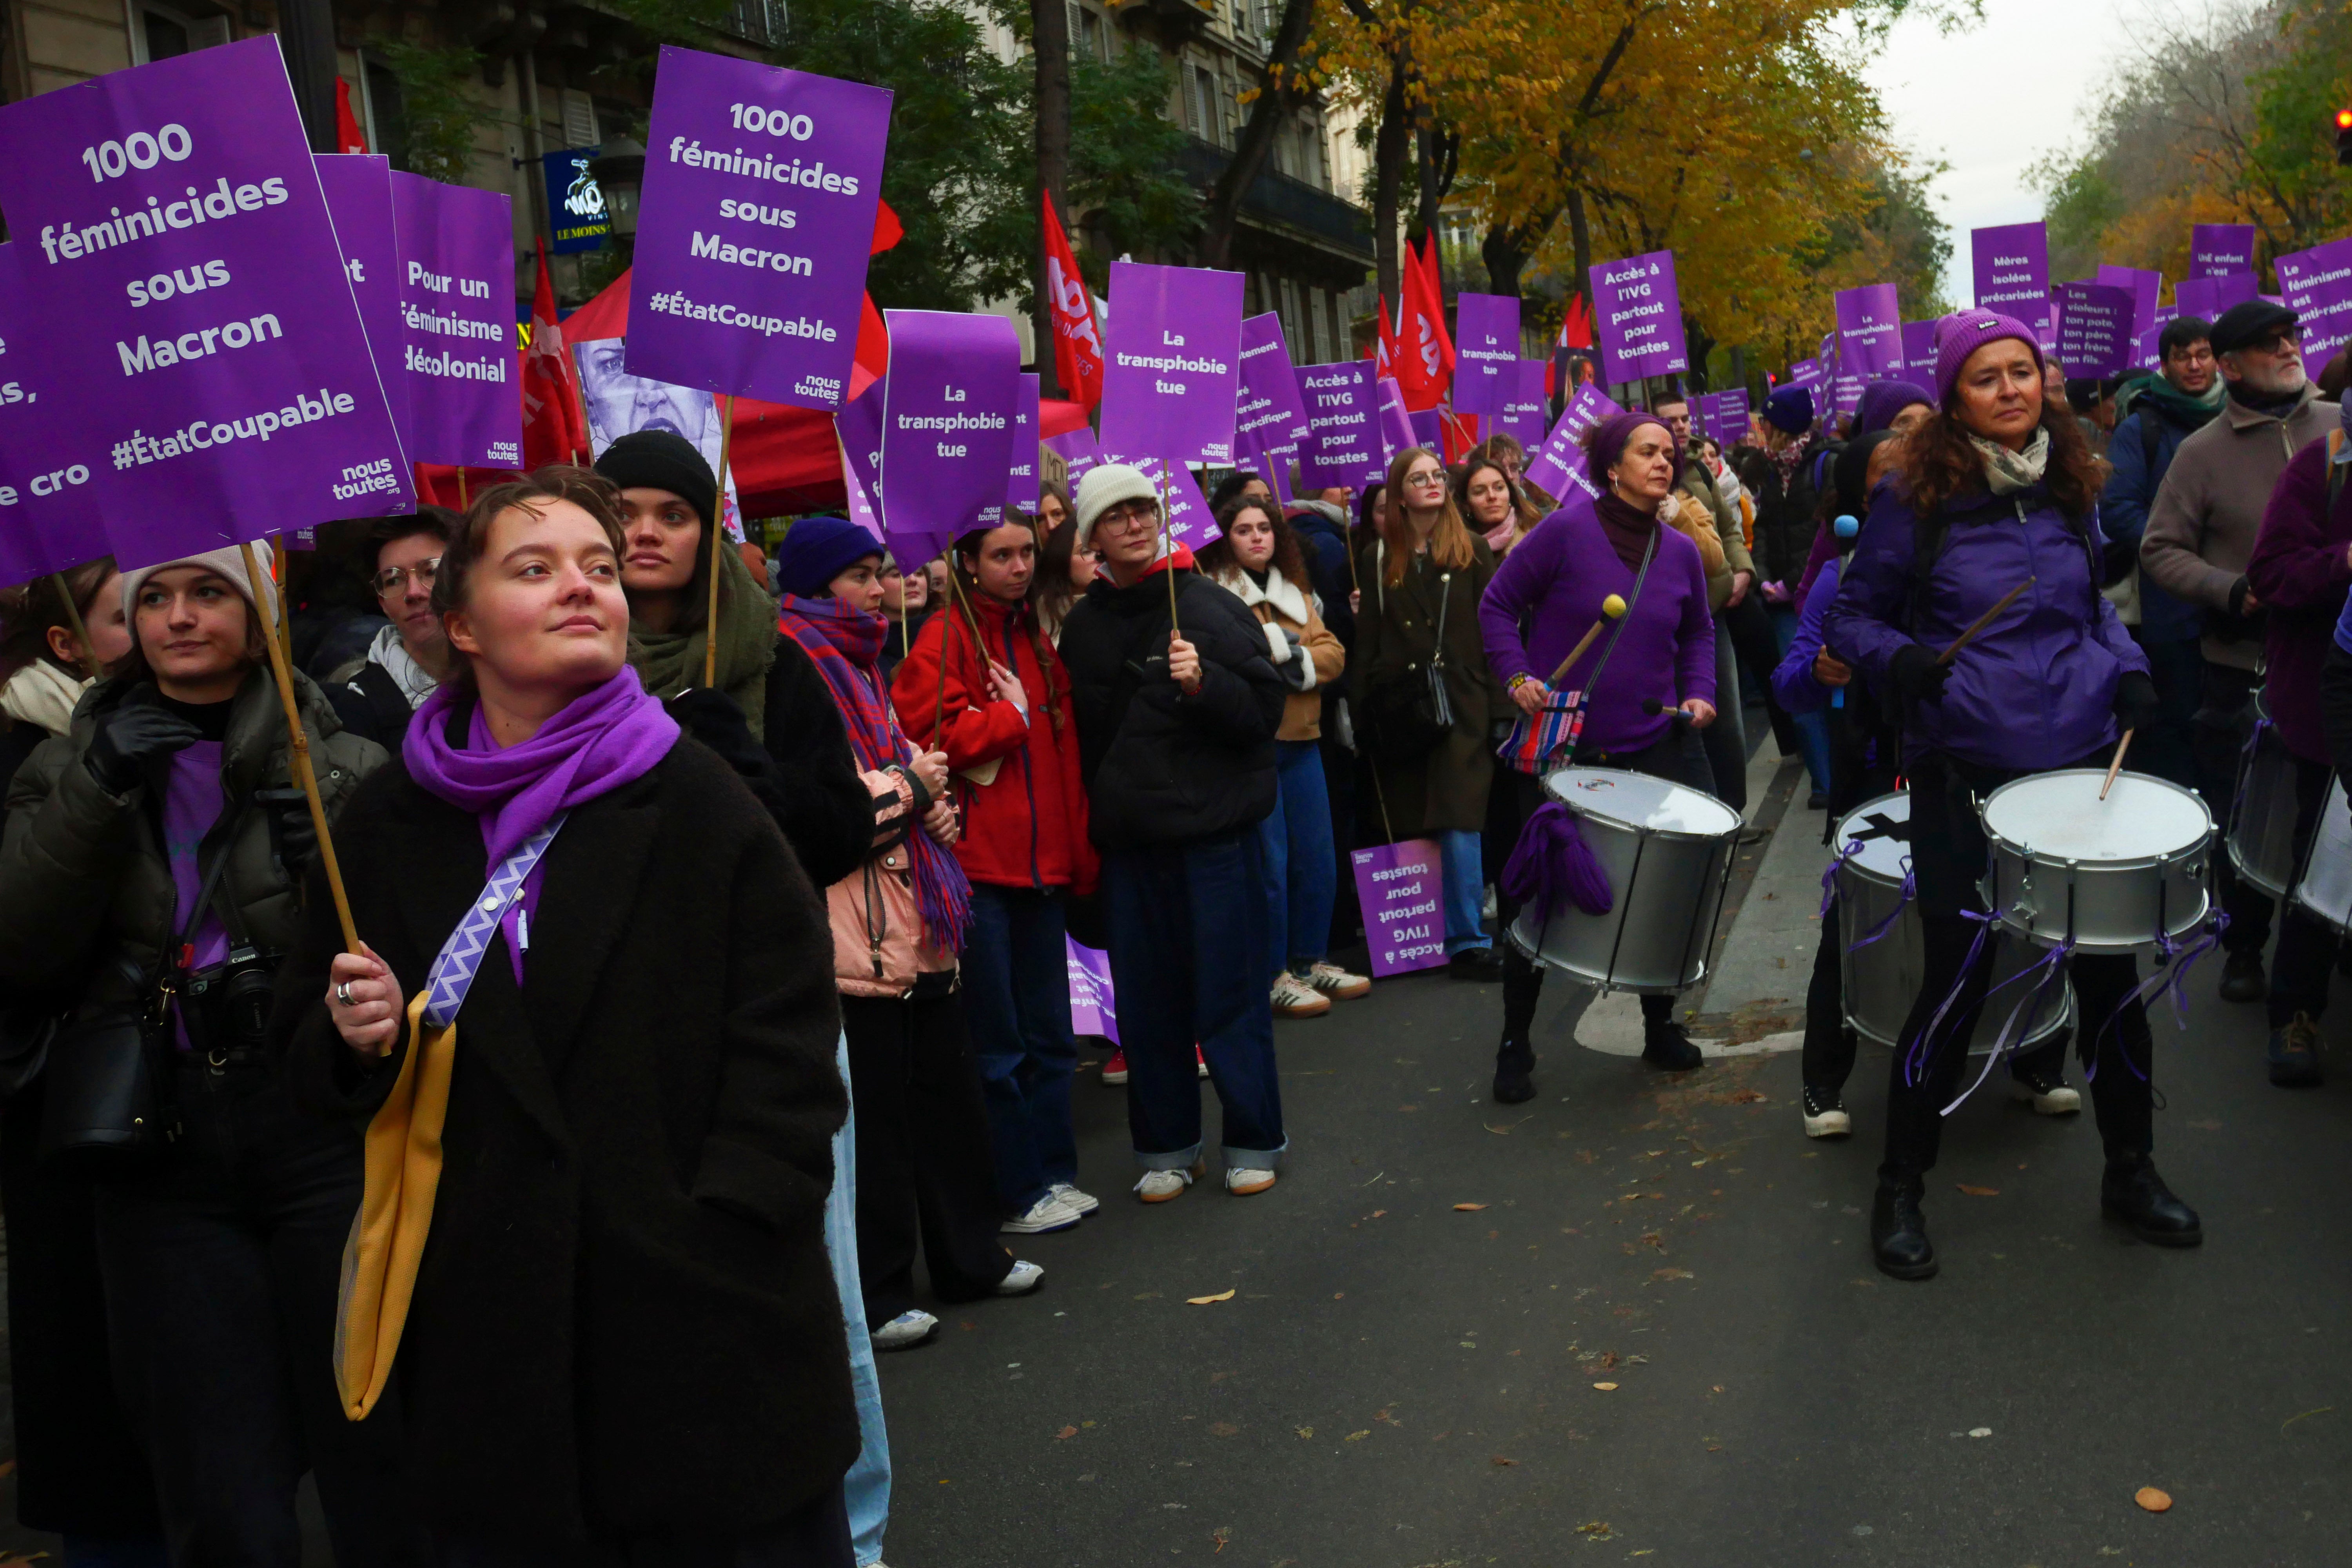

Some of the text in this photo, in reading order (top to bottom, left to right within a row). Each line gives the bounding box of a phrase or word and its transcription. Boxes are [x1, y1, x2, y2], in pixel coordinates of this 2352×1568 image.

[730, 103, 813, 141] 1000
[82, 124, 192, 183] 1000
[670, 136, 858, 196] féminicides
[40, 177, 288, 265] féminicides
[719, 198, 796, 229] sous
[571, 224, 606, 238] MOINS
[691, 232, 812, 276] Macron
[1994, 256, 2029, 267] Mères
[2215, 253, 2244, 263] enfant
[1605, 263, 1660, 285] Accès à
[1993, 272, 2032, 285] isolées
[2283, 265, 2299, 276] Le
[126, 259, 230, 308] sous
[408, 261, 489, 299] Pour un
[2288, 267, 2351, 292] féminisme
[1617, 283, 1651, 301] l'IVG
[1981, 289, 2044, 306] précarisées
[2069, 289, 2087, 299] Les
[2067, 303, 2110, 314] violeurs
[2292, 294, 2311, 308] est
[650, 291, 836, 343] #ÉtatCoupable
[1611, 301, 1664, 325] partout
[2065, 316, 2083, 325] ton
[1163, 330, 1185, 346] La
[1624, 324, 1657, 342] pour
[1843, 323, 1894, 338] transphobie
[2064, 328, 2082, 338] ton
[116, 313, 282, 377] Macron
[1486, 335, 1497, 345] La
[2063, 341, 2081, 350] ton
[1462, 349, 1516, 362] transphobie
[1617, 340, 1670, 359] toustes
[405, 346, 505, 383] décolonial
[1116, 352, 1227, 375] transphobie
[2062, 355, 2079, 364] ton
[1483, 365, 1497, 375] tue
[806, 375, 840, 390] nous
[1156, 379, 1185, 395] tue
[1305, 375, 1349, 388] Accès
[1354, 371, 1363, 384] à
[794, 382, 839, 400] toutes
[944, 385, 965, 401] La
[1318, 392, 1353, 407] l'IVG
[1583, 392, 1595, 406] Le
[111, 388, 354, 470] #ÉtatCoupable
[898, 412, 1005, 434] transphobie
[1239, 410, 1292, 433] spécifique
[1310, 412, 1365, 430] partout
[493, 441, 517, 451] nous
[937, 442, 966, 457] tue
[1207, 442, 1228, 451] nous
[1322, 434, 1357, 448] pour
[1553, 441, 1565, 452] et
[487, 448, 518, 461] toutes
[1201, 448, 1228, 456] toutes
[1314, 452, 1368, 466] toustes
[342, 458, 392, 482] nous
[1546, 453, 1600, 500] anti-fasciste
[332, 473, 397, 500] toutes
[978, 512, 1000, 522] toutes
[1372, 863, 1428, 882] toustes
[1386, 882, 1422, 899] pour
[1379, 899, 1436, 923] partout
[1394, 924, 1430, 942] l'IVG
[232, 954, 256, 963] Canon
[1385, 942, 1444, 964] Accès à
